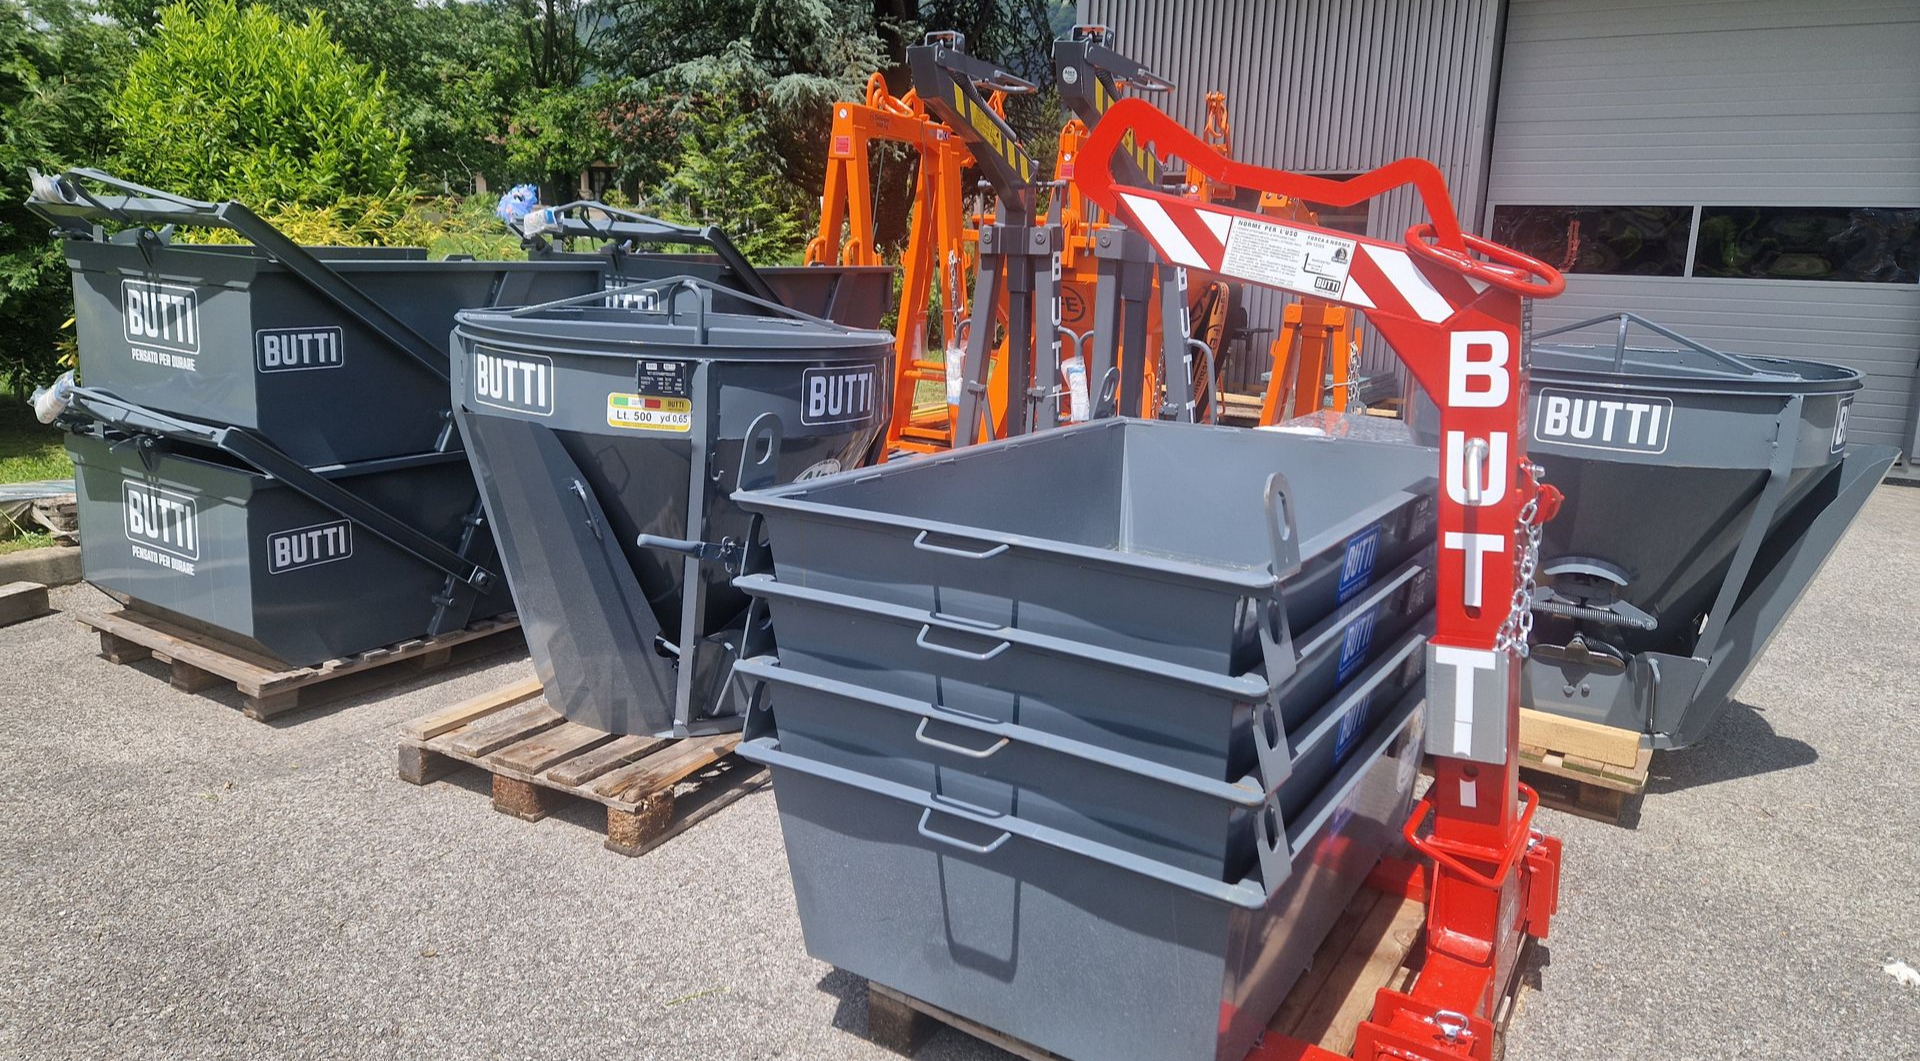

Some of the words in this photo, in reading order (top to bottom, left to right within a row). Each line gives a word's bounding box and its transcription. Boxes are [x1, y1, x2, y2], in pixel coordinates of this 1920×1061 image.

[1238, 220, 1261, 230] NORME
[1264, 225, 1277, 233] PER
[1279, 228, 1298, 238] L'USO
[1316, 276, 1340, 292] BUTTI
[128, 289, 194, 345] BUTTI
[131, 347, 158, 364] PENSATO
[159, 352, 171, 367] PER
[264, 332, 336, 367] BUTTI
[477, 353, 545, 407] BUTTI
[809, 372, 872, 417] BUTTI
[617, 410, 629, 421] Lt.
[634, 411, 652, 422] 500
[660, 413, 671, 423] yd
[668, 400, 684, 408] BUTTI
[1544, 396, 1661, 445] BUTTI
[128, 489, 193, 551] BUTTI
[132, 545, 159, 564] PENSATO
[159, 553, 171, 568] PER
[274, 525, 346, 568] BUTTI
[1343, 532, 1378, 583] BUTTI
[1342, 610, 1376, 664] BUTTI
